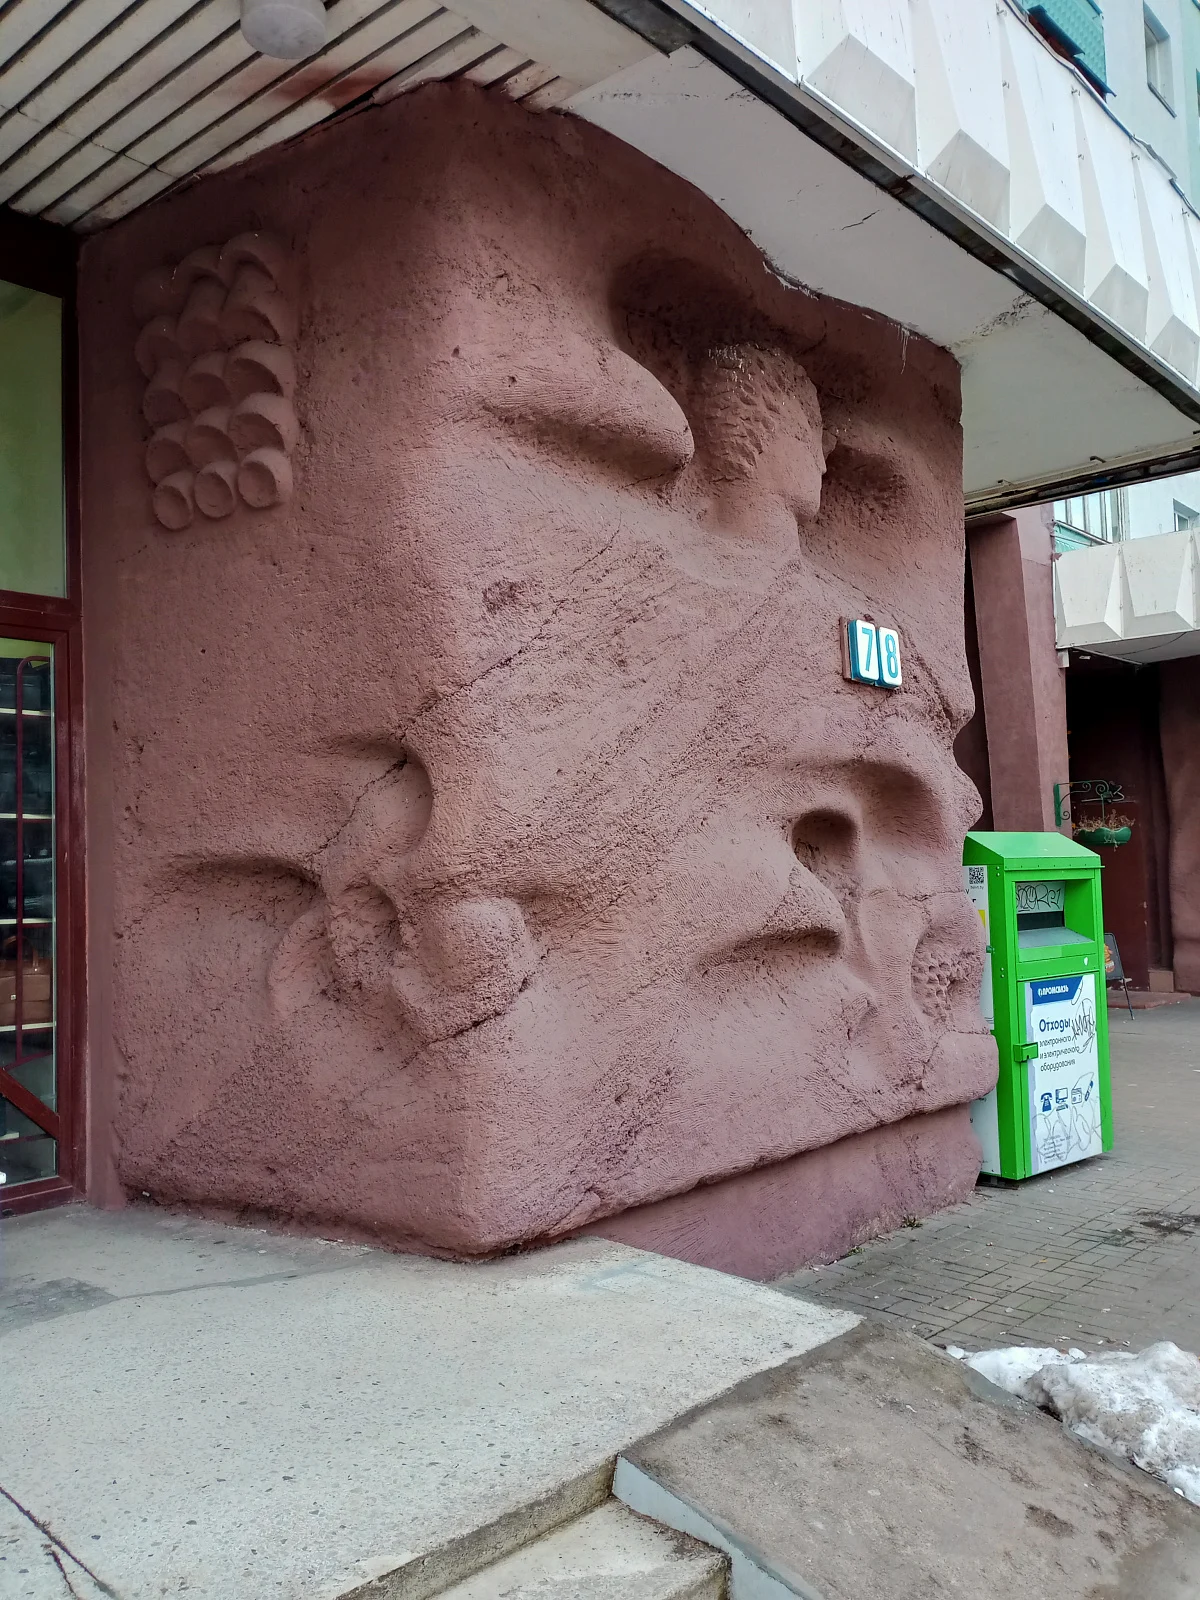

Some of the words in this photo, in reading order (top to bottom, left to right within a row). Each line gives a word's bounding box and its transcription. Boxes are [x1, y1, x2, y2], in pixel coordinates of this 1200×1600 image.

[861, 626, 899, 679] 78
[1039, 1018, 1070, 1032] Отходы
[1039, 1035, 1071, 1047] электронного
[1040, 1059, 1075, 1072] оборудования
